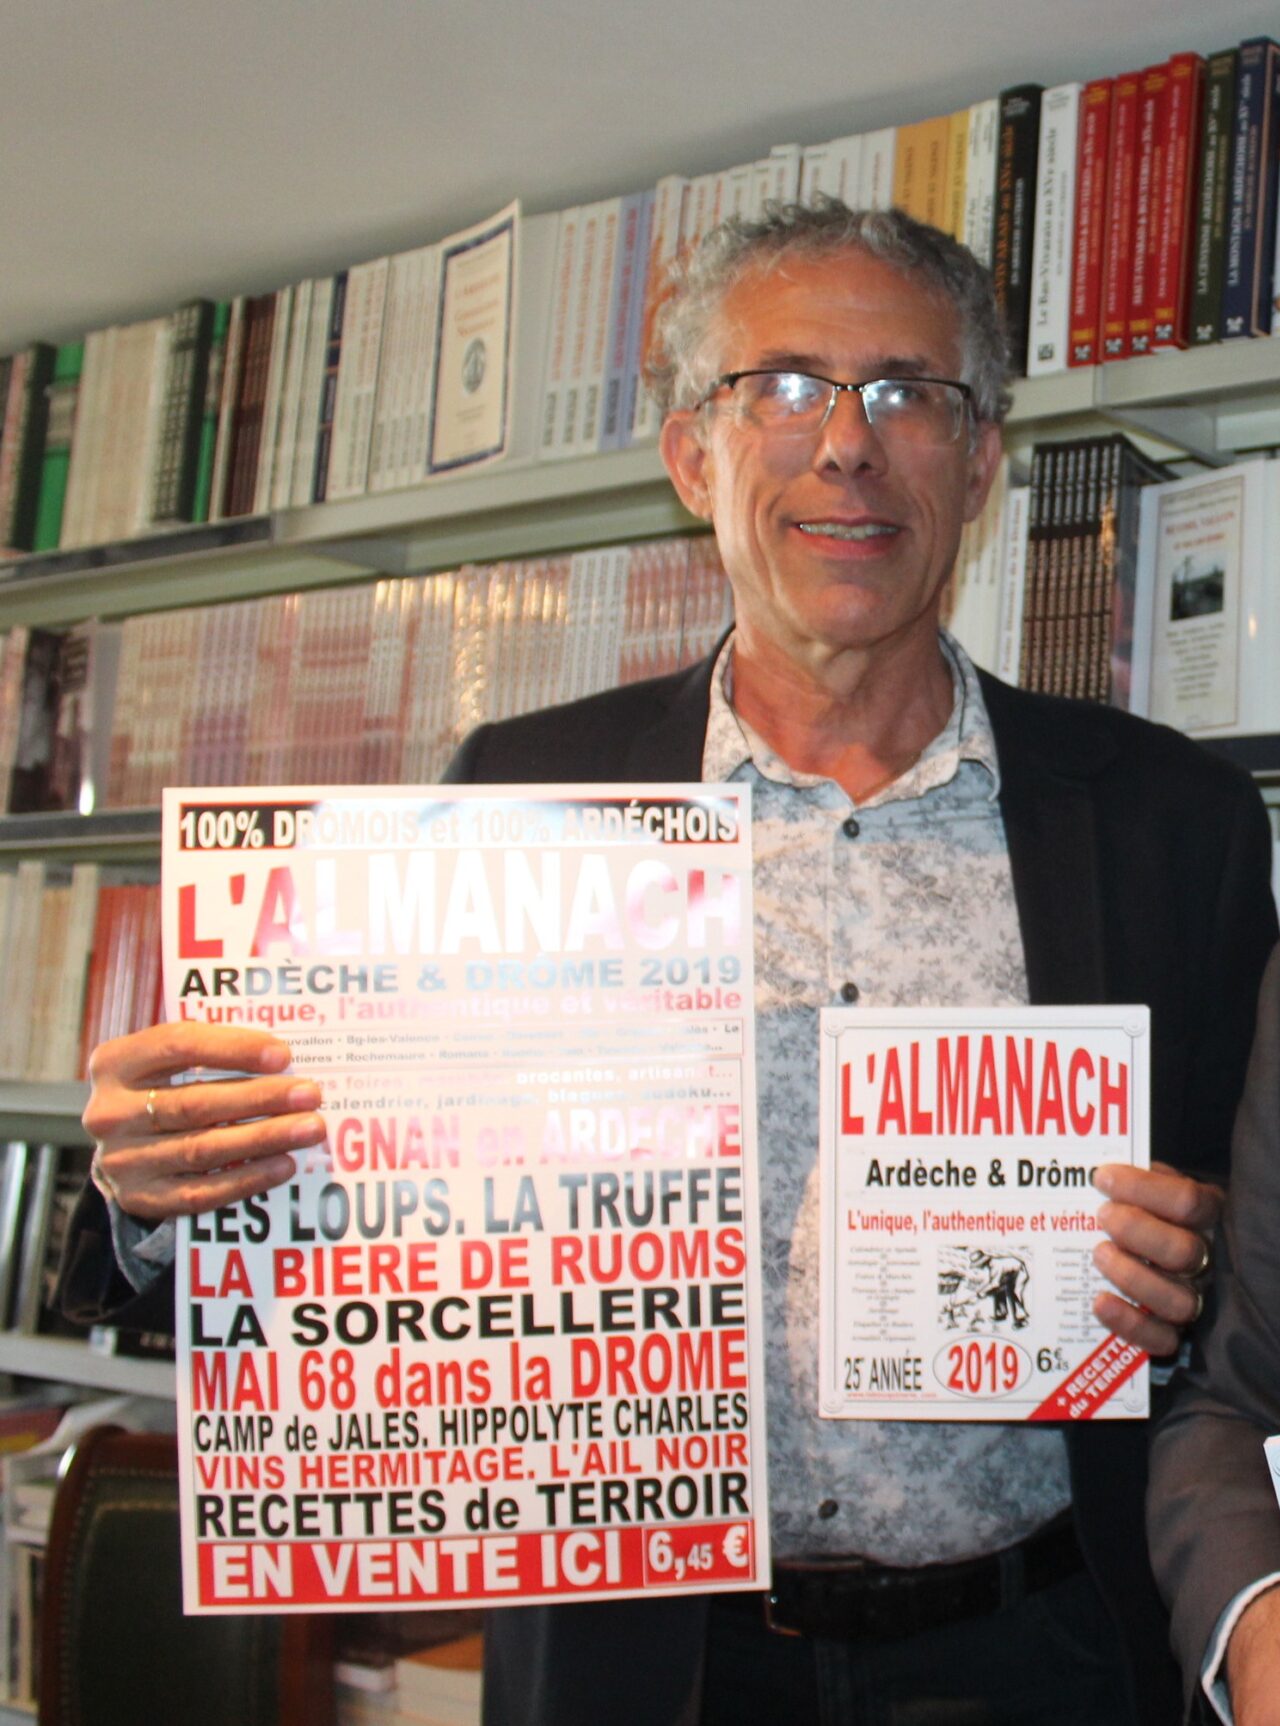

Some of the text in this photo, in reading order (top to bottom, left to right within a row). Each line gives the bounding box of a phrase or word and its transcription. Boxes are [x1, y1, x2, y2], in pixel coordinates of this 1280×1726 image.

[180, 799, 739, 849] 100% DRÔMOIS et 100% ARDÉCHOIS
[177, 850, 742, 959] L'ALMANACH
[179, 952, 742, 997] ARDÈCHE & DRÔME 2019
[178, 999, 326, 1027] L'unique,
[559, 991, 593, 1013] et
[605, 986, 743, 1013] véritable
[319, 1096, 430, 1112] calendrier,
[840, 1034, 1129, 1137] L'ALMANACH
[865, 1158, 977, 1188] Ardèche
[987, 1160, 1006, 1187] &
[189, 1190, 271, 1243] LES
[484, 1175, 544, 1235] LA
[558, 1167, 743, 1230] TRUFFE
[847, 1208, 1104, 1237] L'unique, l'authentique et vérita
[189, 1227, 746, 1299] LA BIERE DE RUOMS
[190, 1284, 746, 1347] LA SORCELLERIE
[192, 1330, 747, 1412] MAI 68 dans la DROME
[868, 1349, 922, 1391] ANNÉE
[947, 1342, 1019, 1394] 2019
[1065, 1335, 1128, 1397] RECETT
[194, 1392, 748, 1453] CAMP de JALES. HIPPOLYTE CHARLES
[1068, 1397, 1090, 1418] du
[195, 1433, 748, 1490] VINS HERMITAGE. L'AIL NOIR
[198, 1472, 749, 1538] RECETTES de TERROIR
[213, 1543, 293, 1598] EN
[311, 1535, 520, 1597] VENTE
[541, 1531, 622, 1588] ICI
